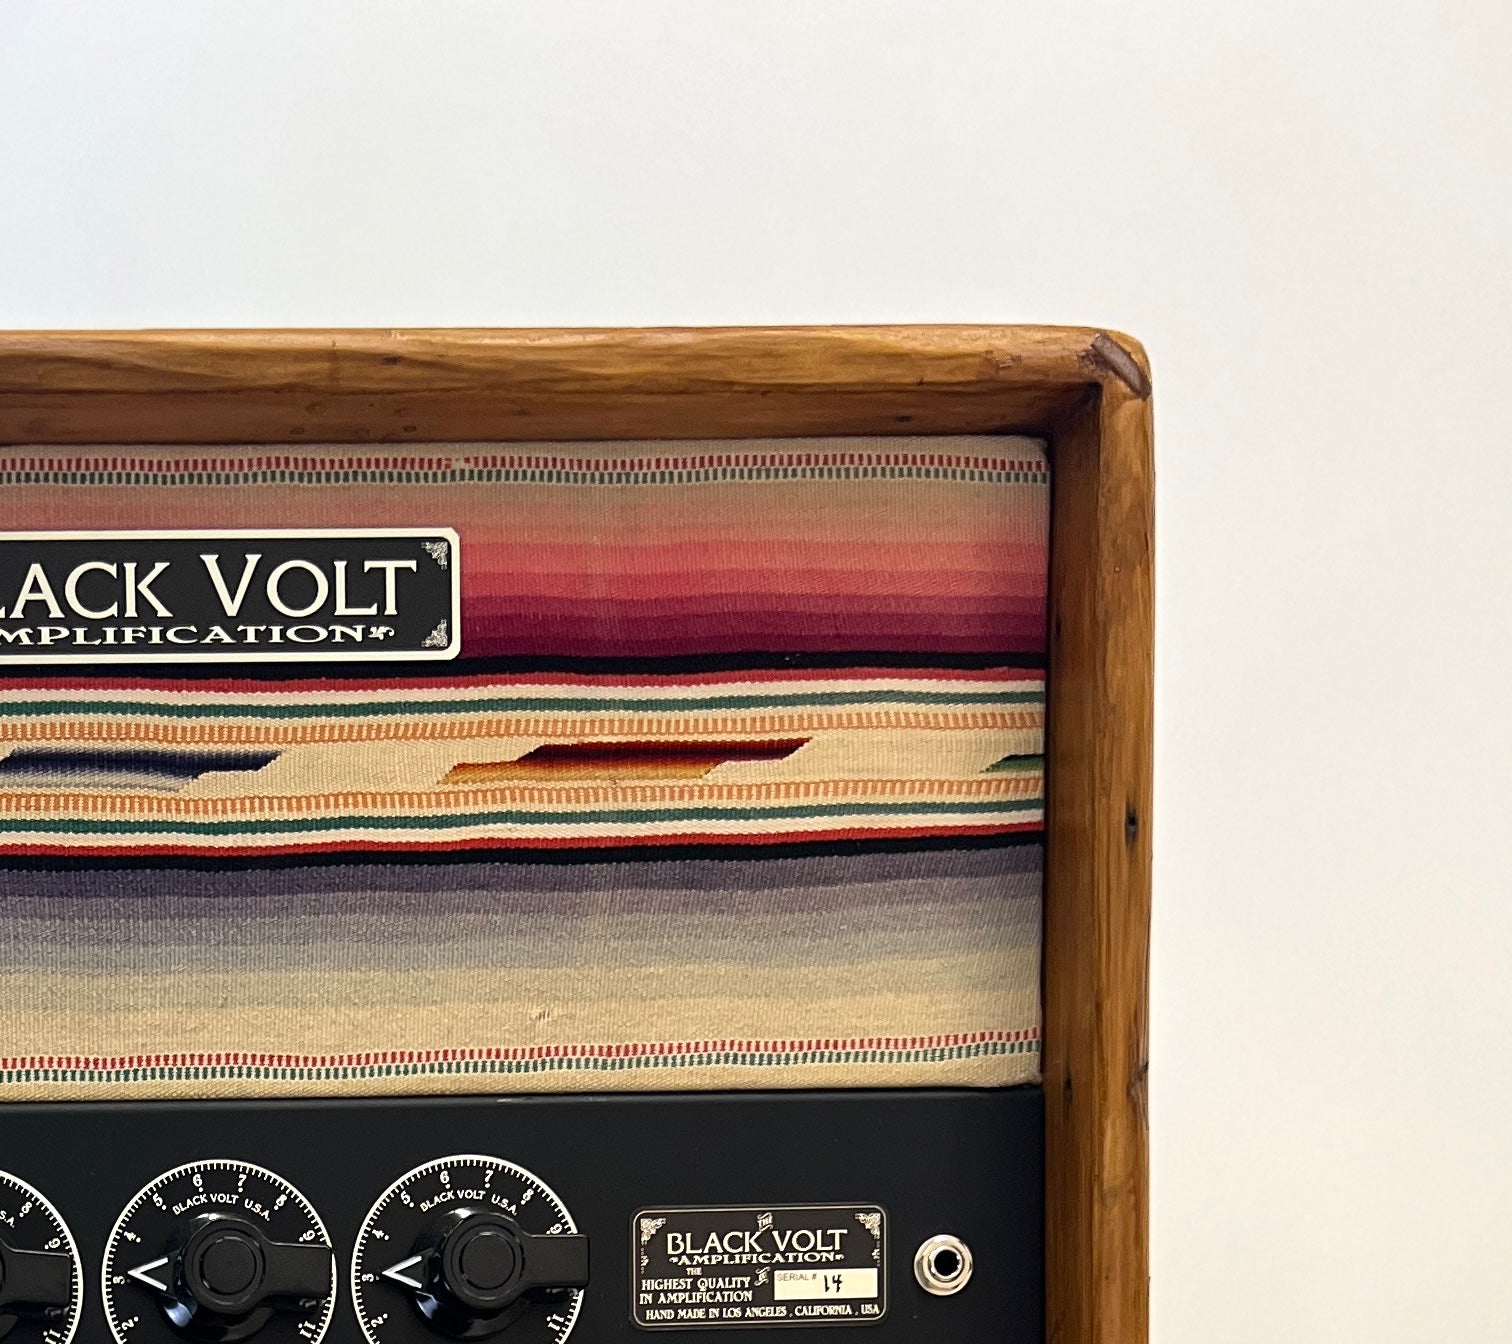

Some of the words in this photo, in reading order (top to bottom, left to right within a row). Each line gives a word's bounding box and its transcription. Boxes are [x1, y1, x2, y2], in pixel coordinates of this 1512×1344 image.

[200, 553, 417, 618] VOLT
[193, 1174, 202, 1186] 6
[238, 1174, 247, 1187] 7
[440, 1171, 449, 1183] 6
[484, 1170, 493, 1183] 7
[152, 1193, 163, 1208] 5
[276, 1194, 288, 1207] 8
[400, 1190, 411, 1205] 5
[419, 1190, 455, 1213] BLACK
[457, 1190, 486, 1200] VOLT
[522, 1188, 534, 1202] 8
[21, 1201, 33, 1214] 8
[172, 1194, 208, 1216] BLACK
[210, 1193, 239, 1205] VOLT
[123, 1230, 136, 1241] 4
[372, 1229, 385, 1240] 4
[549, 1223, 562, 1235] 9
[303, 1230, 316, 1242] 9
[667, 1231, 763, 1255] BLACK
[772, 1229, 847, 1252] VOLT
[48, 1238, 61, 1249] 9
[677, 1252, 835, 1265] AMPLIFICATION
[362, 1273, 374, 1283] 3
[686, 1267, 702, 1276] THE
[777, 1272, 809, 1282] SERIAL
[112, 1275, 125, 1285] 3
[641, 1278, 693, 1291] HIGHEST
[697, 1276, 751, 1292] QUALITY
[824, 1274, 842, 1293] 14
[639, 1293, 653, 1305] IN
[657, 1290, 753, 1304] AMPLIFICATION
[646, 1309, 675, 1320] HAND
[677, 1308, 706, 1319] MADE
[708, 1308, 720, 1319] IN
[722, 1307, 742, 1318] LOS
[794, 1304, 852, 1316] CALIFORNIA
[860, 1304, 880, 1315] USA
[122, 1320, 134, 1331] 2
[371, 1317, 383, 1328] 2
